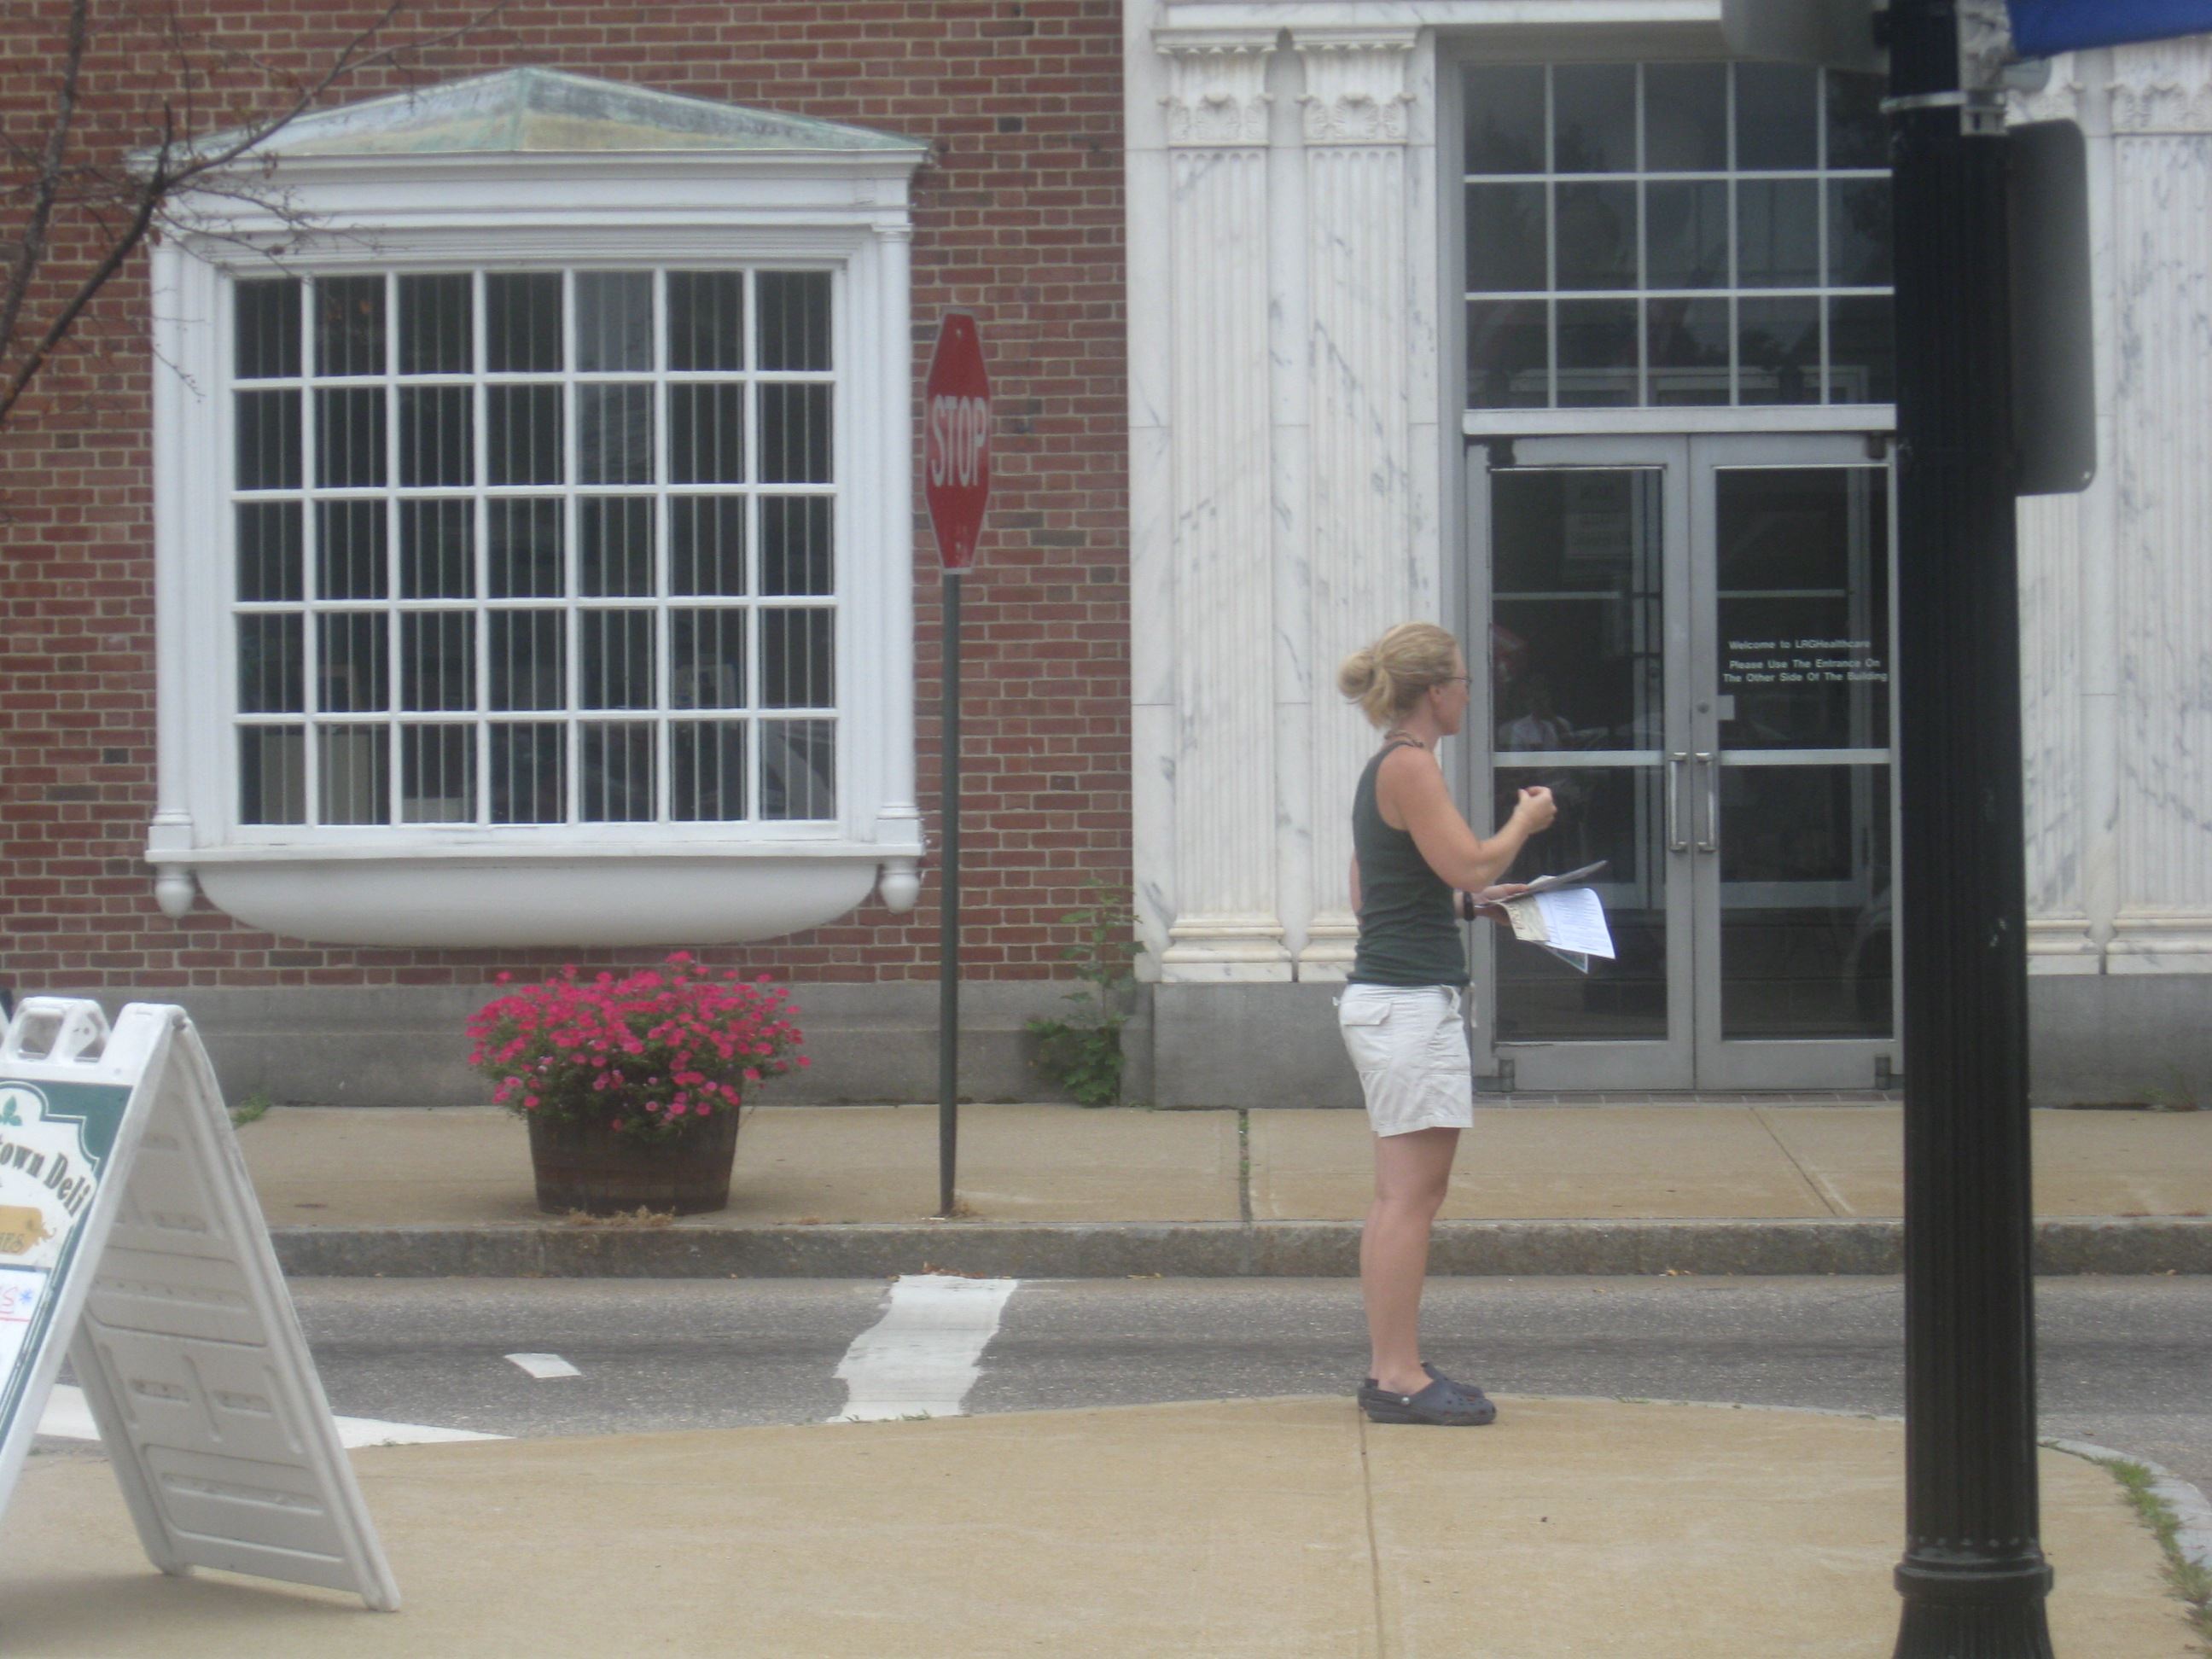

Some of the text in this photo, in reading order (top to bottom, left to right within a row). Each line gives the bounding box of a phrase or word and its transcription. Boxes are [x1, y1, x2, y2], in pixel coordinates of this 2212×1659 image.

[931, 394, 987, 487] STOP
[1729, 641, 1776, 649] Welcome
[1729, 658, 1881, 669] Please Use The Entrance On
[1723, 672, 1888, 682] The Other Side Of The Building
[0, 1133, 91, 1218] own Deli
